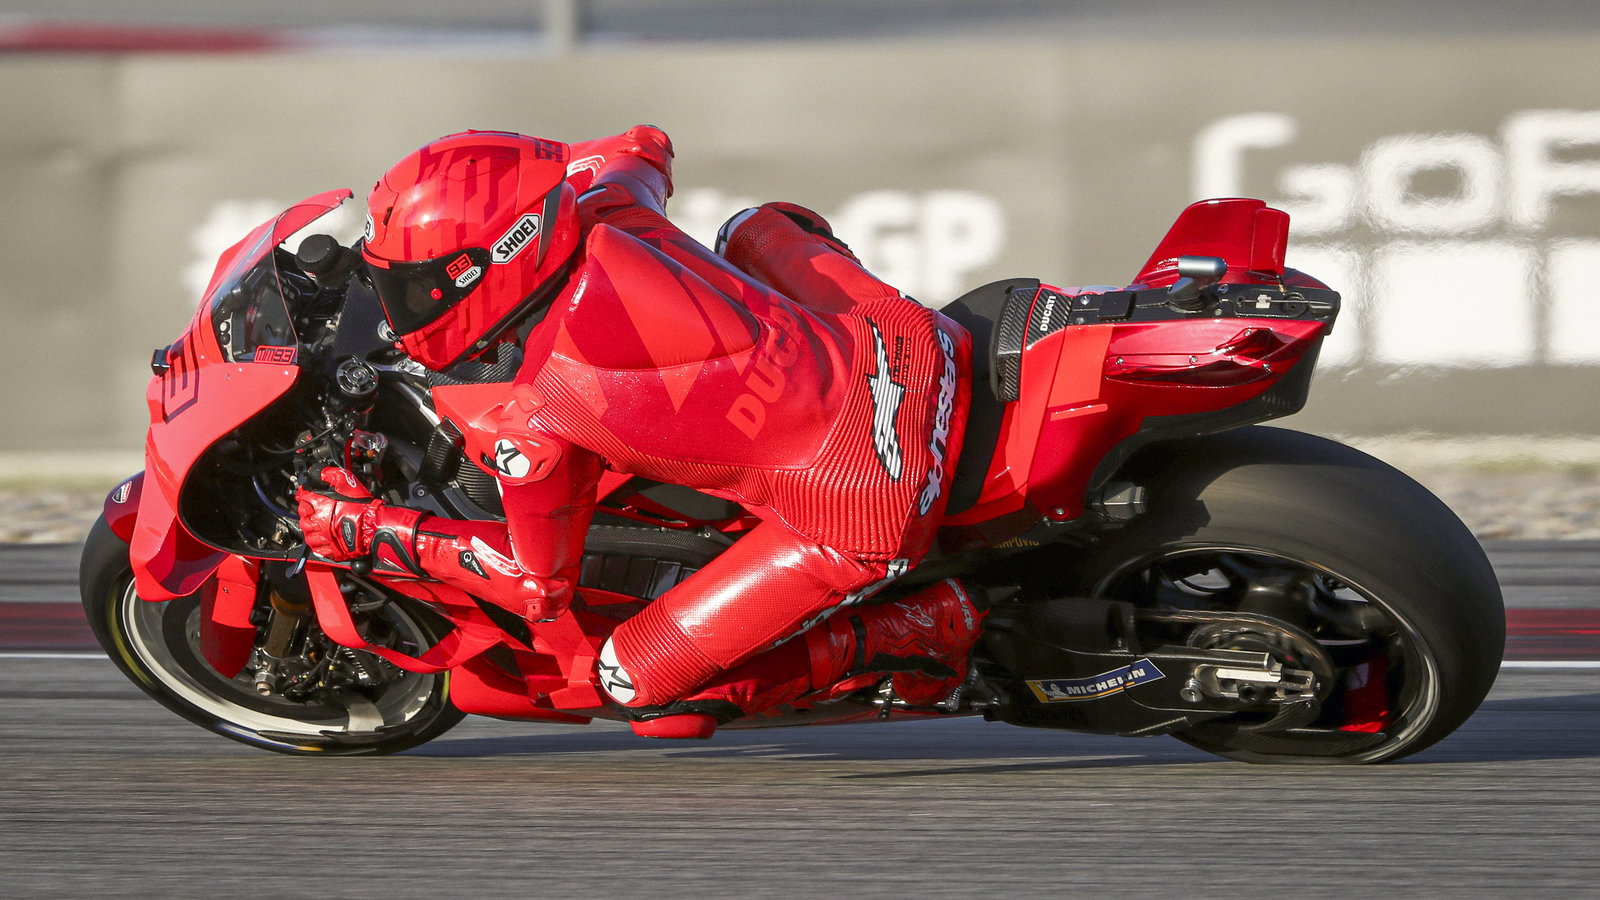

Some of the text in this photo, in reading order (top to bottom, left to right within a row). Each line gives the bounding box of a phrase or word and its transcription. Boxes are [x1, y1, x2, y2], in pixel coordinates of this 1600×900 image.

[496, 218, 537, 260] SHOEI
[448, 256, 470, 278] 93
[459, 269, 479, 285] SHOEI
[1039, 295, 1057, 332] DUCATI
